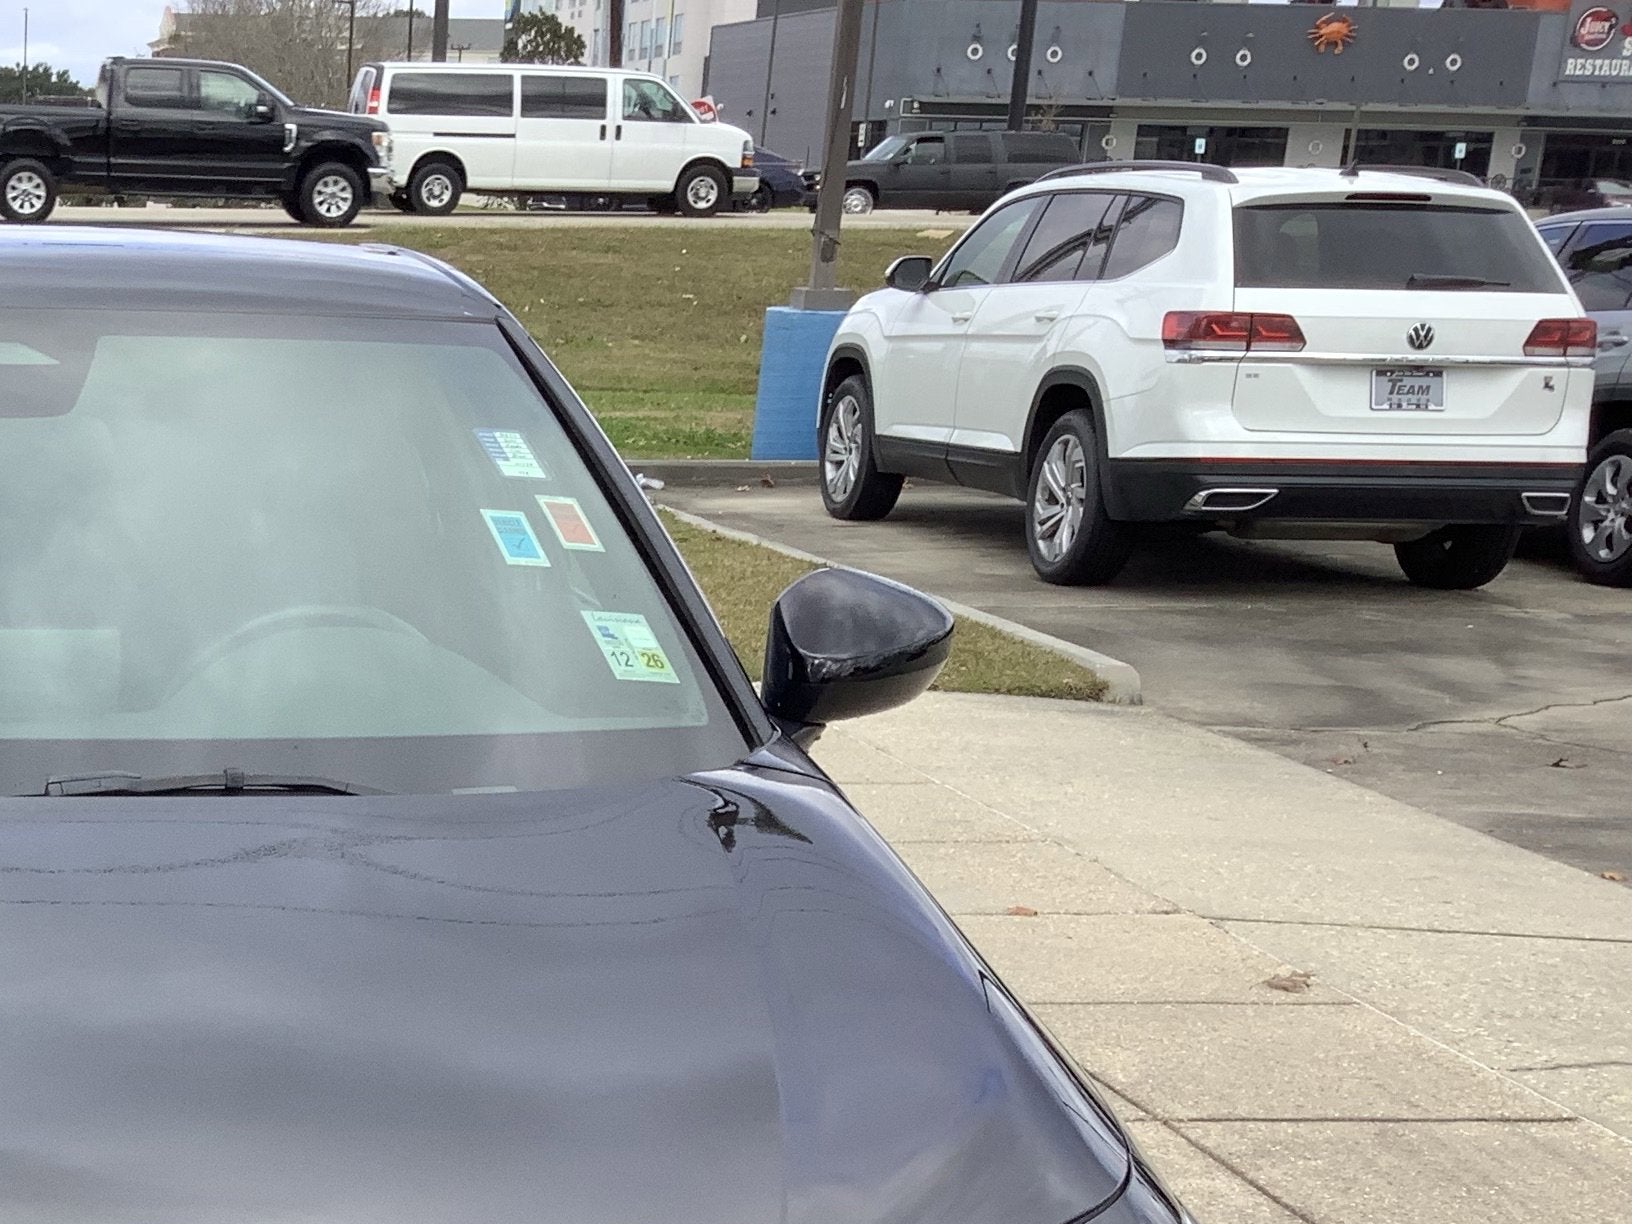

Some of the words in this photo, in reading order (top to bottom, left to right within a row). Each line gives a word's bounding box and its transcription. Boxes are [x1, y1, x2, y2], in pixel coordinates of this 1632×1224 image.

[1565, 58, 1632, 76] RESTAUR
[1388, 378, 1431, 396] TEAM
[611, 652, 634, 667] 12
[641, 652, 664, 669] 26
